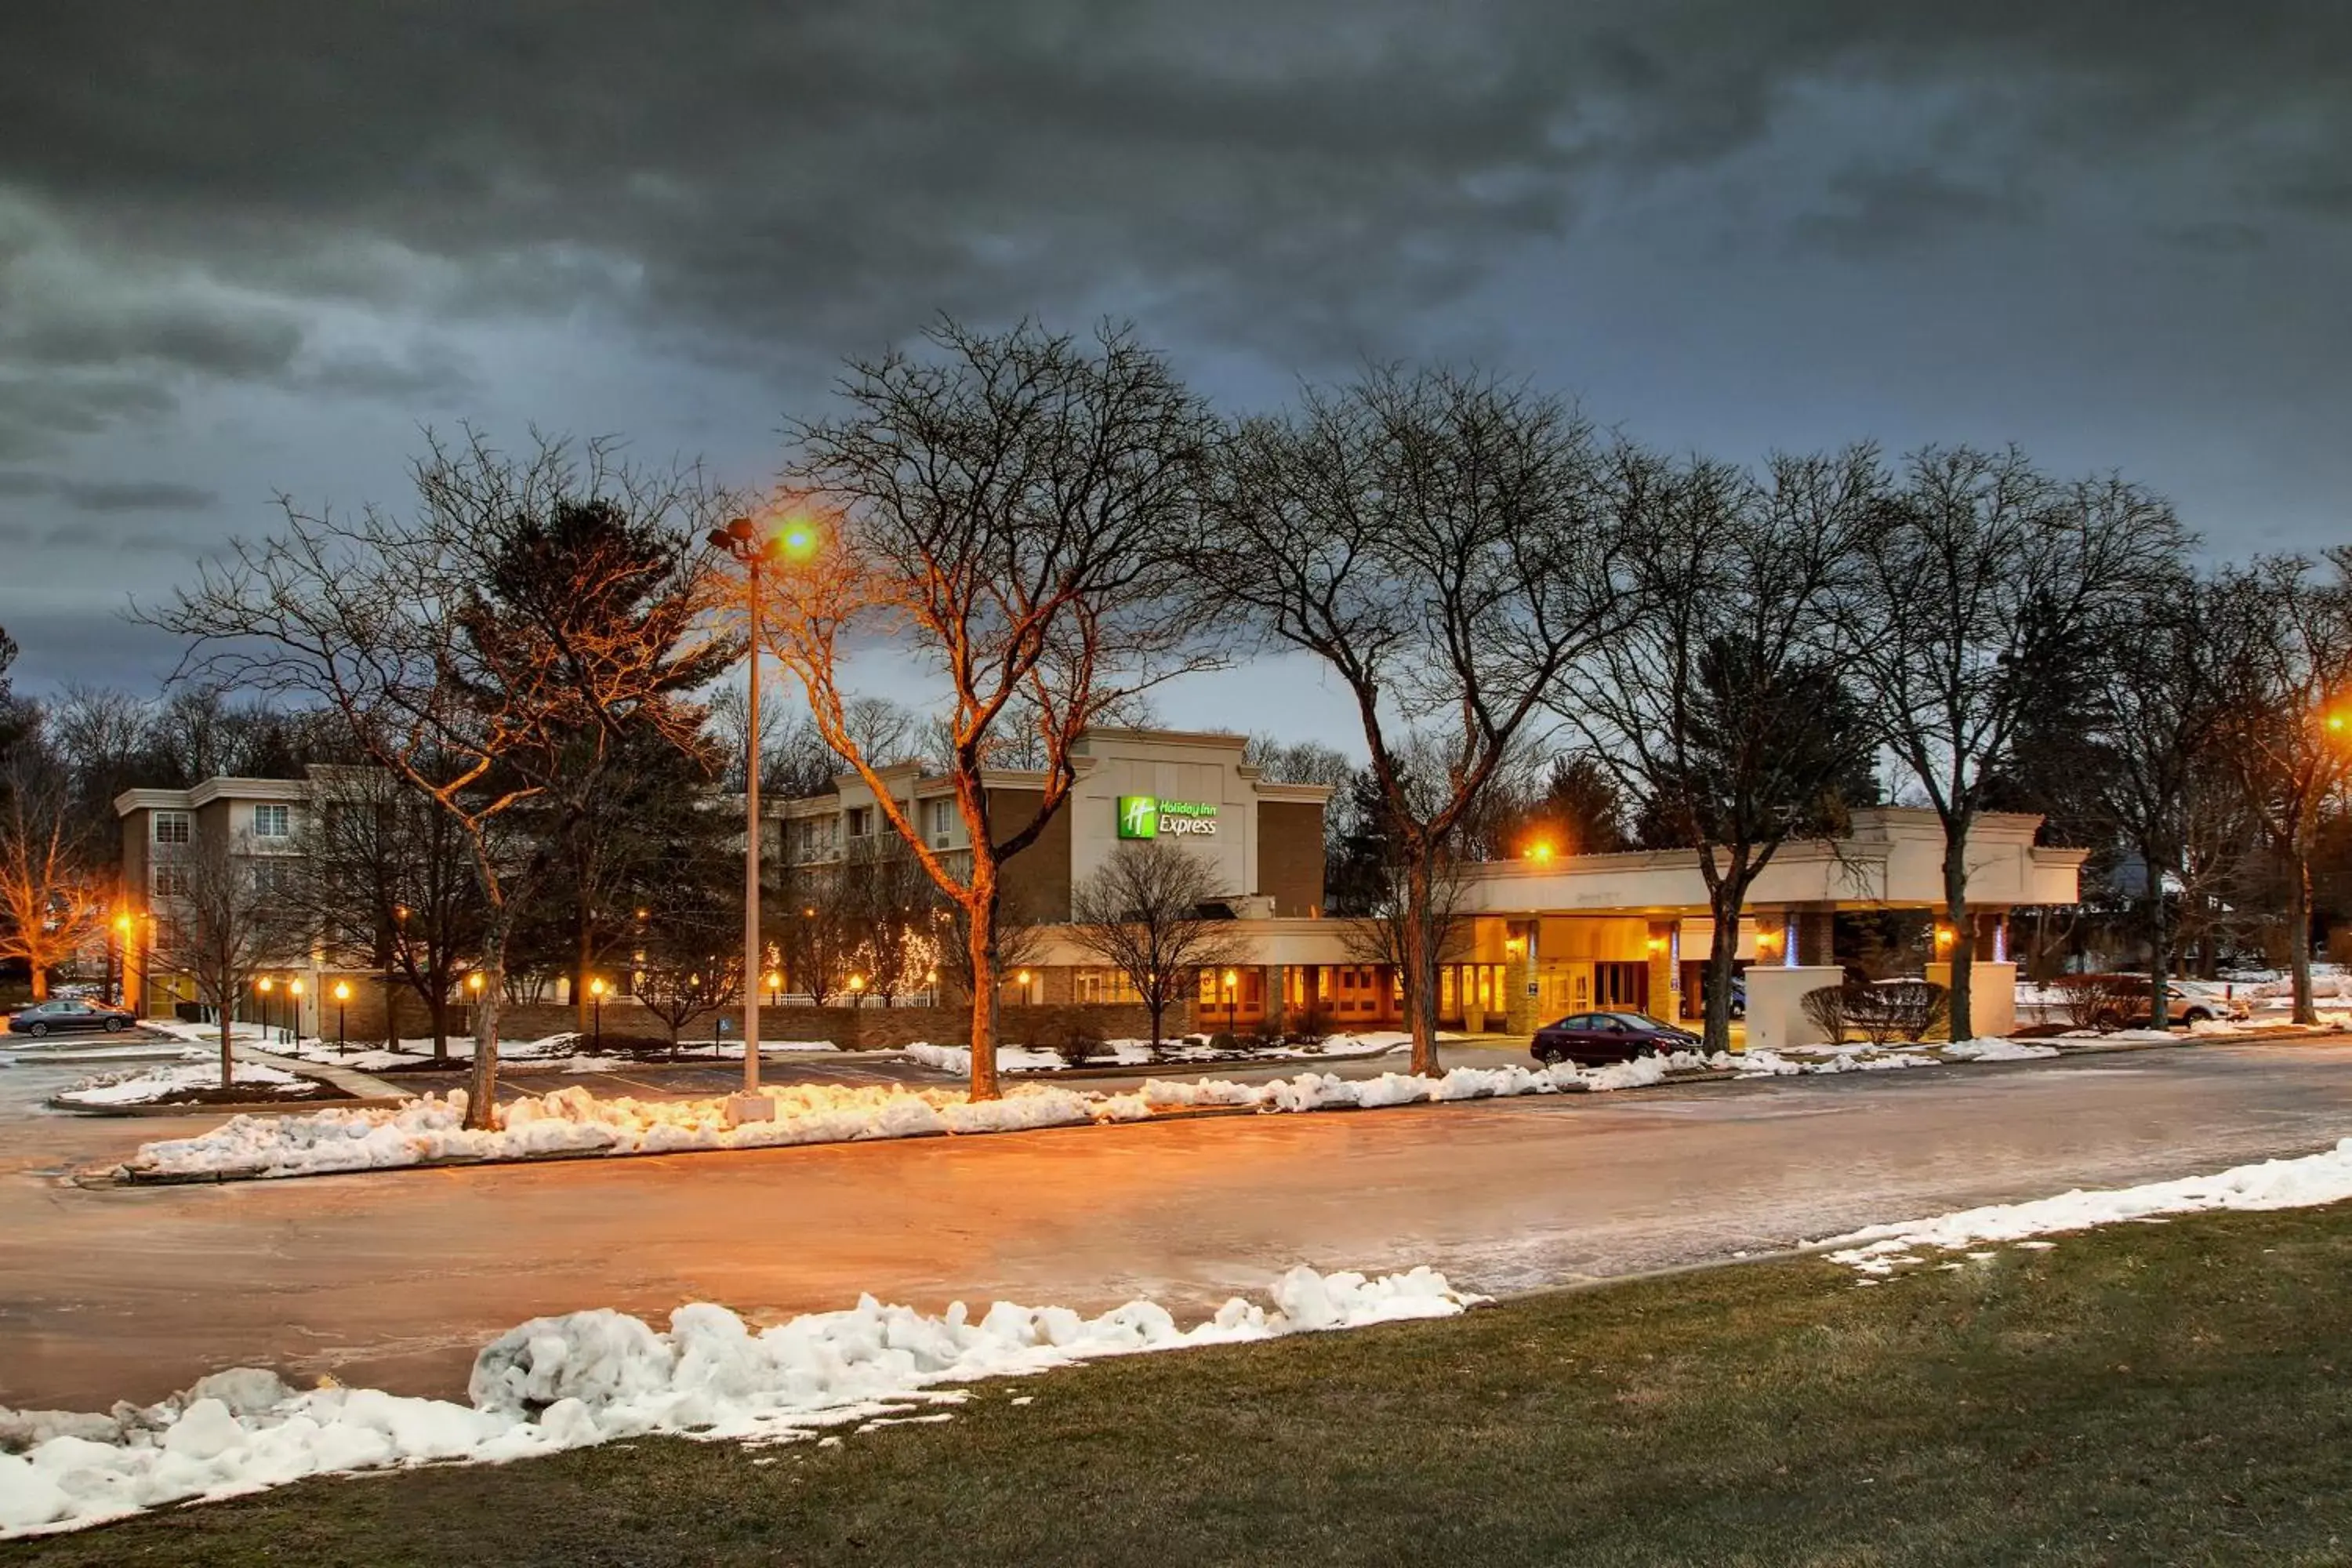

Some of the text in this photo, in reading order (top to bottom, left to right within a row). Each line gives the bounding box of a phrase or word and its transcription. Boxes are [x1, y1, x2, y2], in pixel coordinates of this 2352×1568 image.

[1160, 800, 1217, 817] Holiday Inn
[1160, 814, 1217, 837] Express
